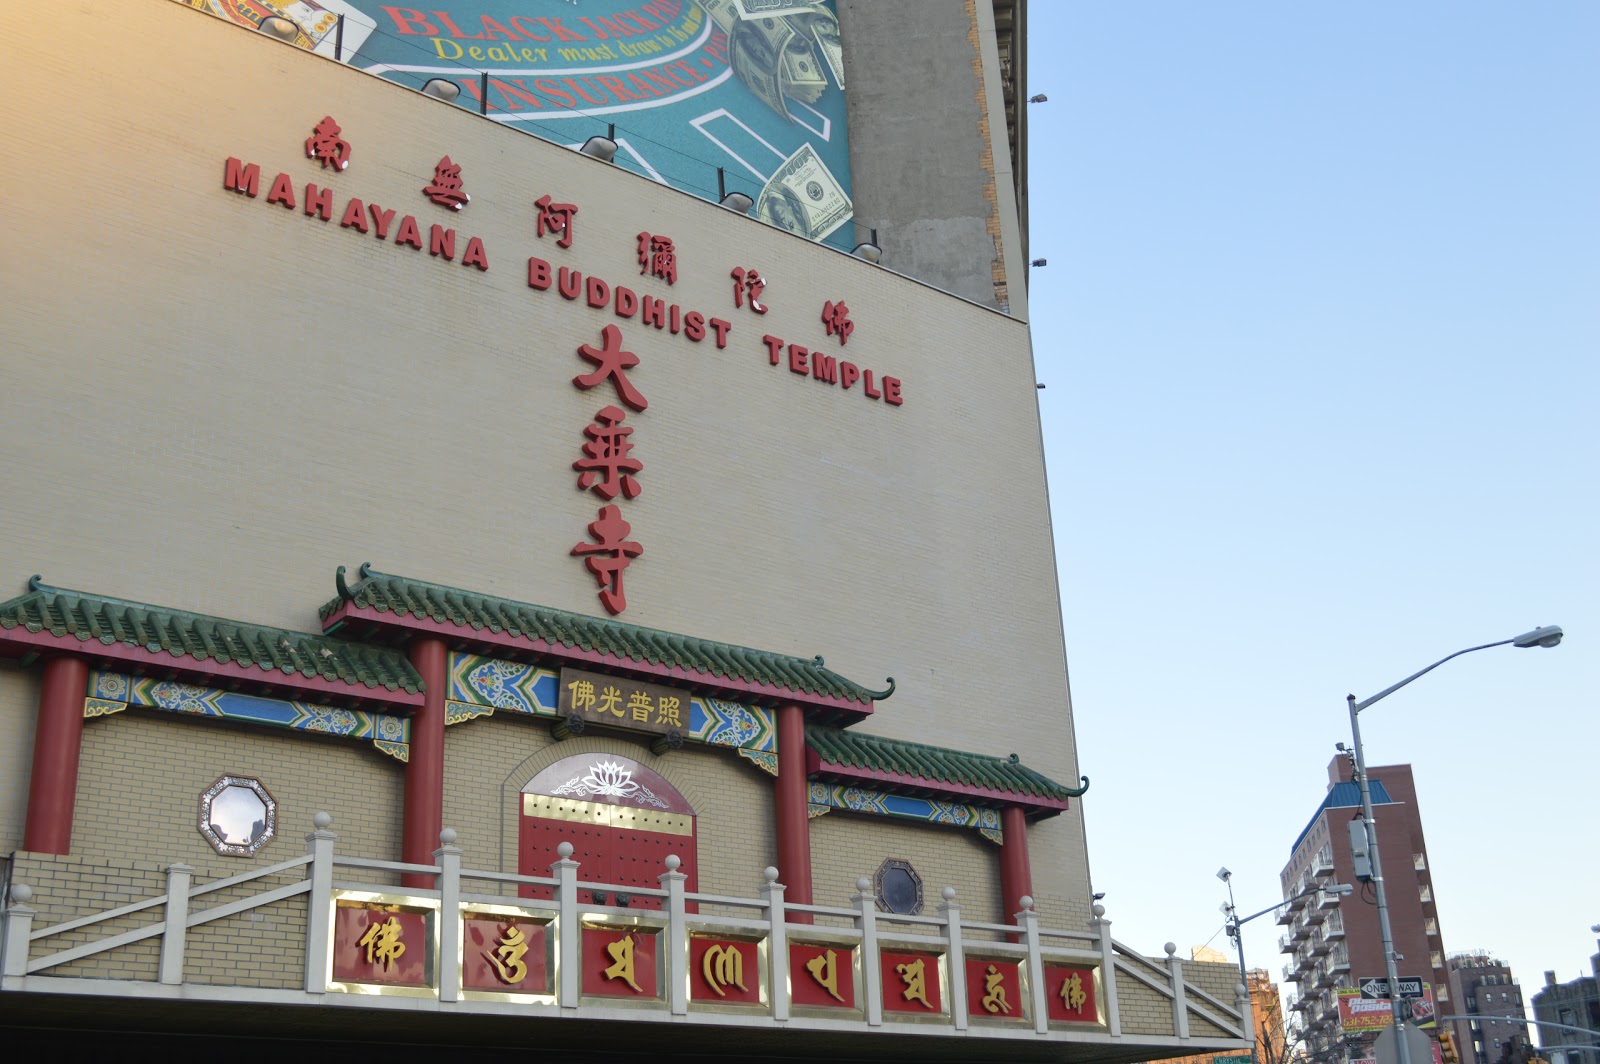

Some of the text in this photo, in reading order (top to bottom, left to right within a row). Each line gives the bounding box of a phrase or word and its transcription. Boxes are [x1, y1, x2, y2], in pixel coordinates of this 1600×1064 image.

[379, 4, 587, 41] BLACK
[576, 10, 661, 42] JACK
[429, 37, 548, 62] Dealer
[557, 41, 620, 62] must
[618, 40, 663, 58] draw
[654, 34, 676, 48] to
[666, 25, 689, 42] 16
[457, 60, 708, 111] INSURANCE
[224, 156, 904, 406] MAHAYANA BUDDHIST TEMPLE
[568, 680, 682, 728] 佛光普照
[360, 916, 406, 971] 佛
[1059, 972, 1087, 1015] 佛
[1366, 984, 1386, 993] ONE
